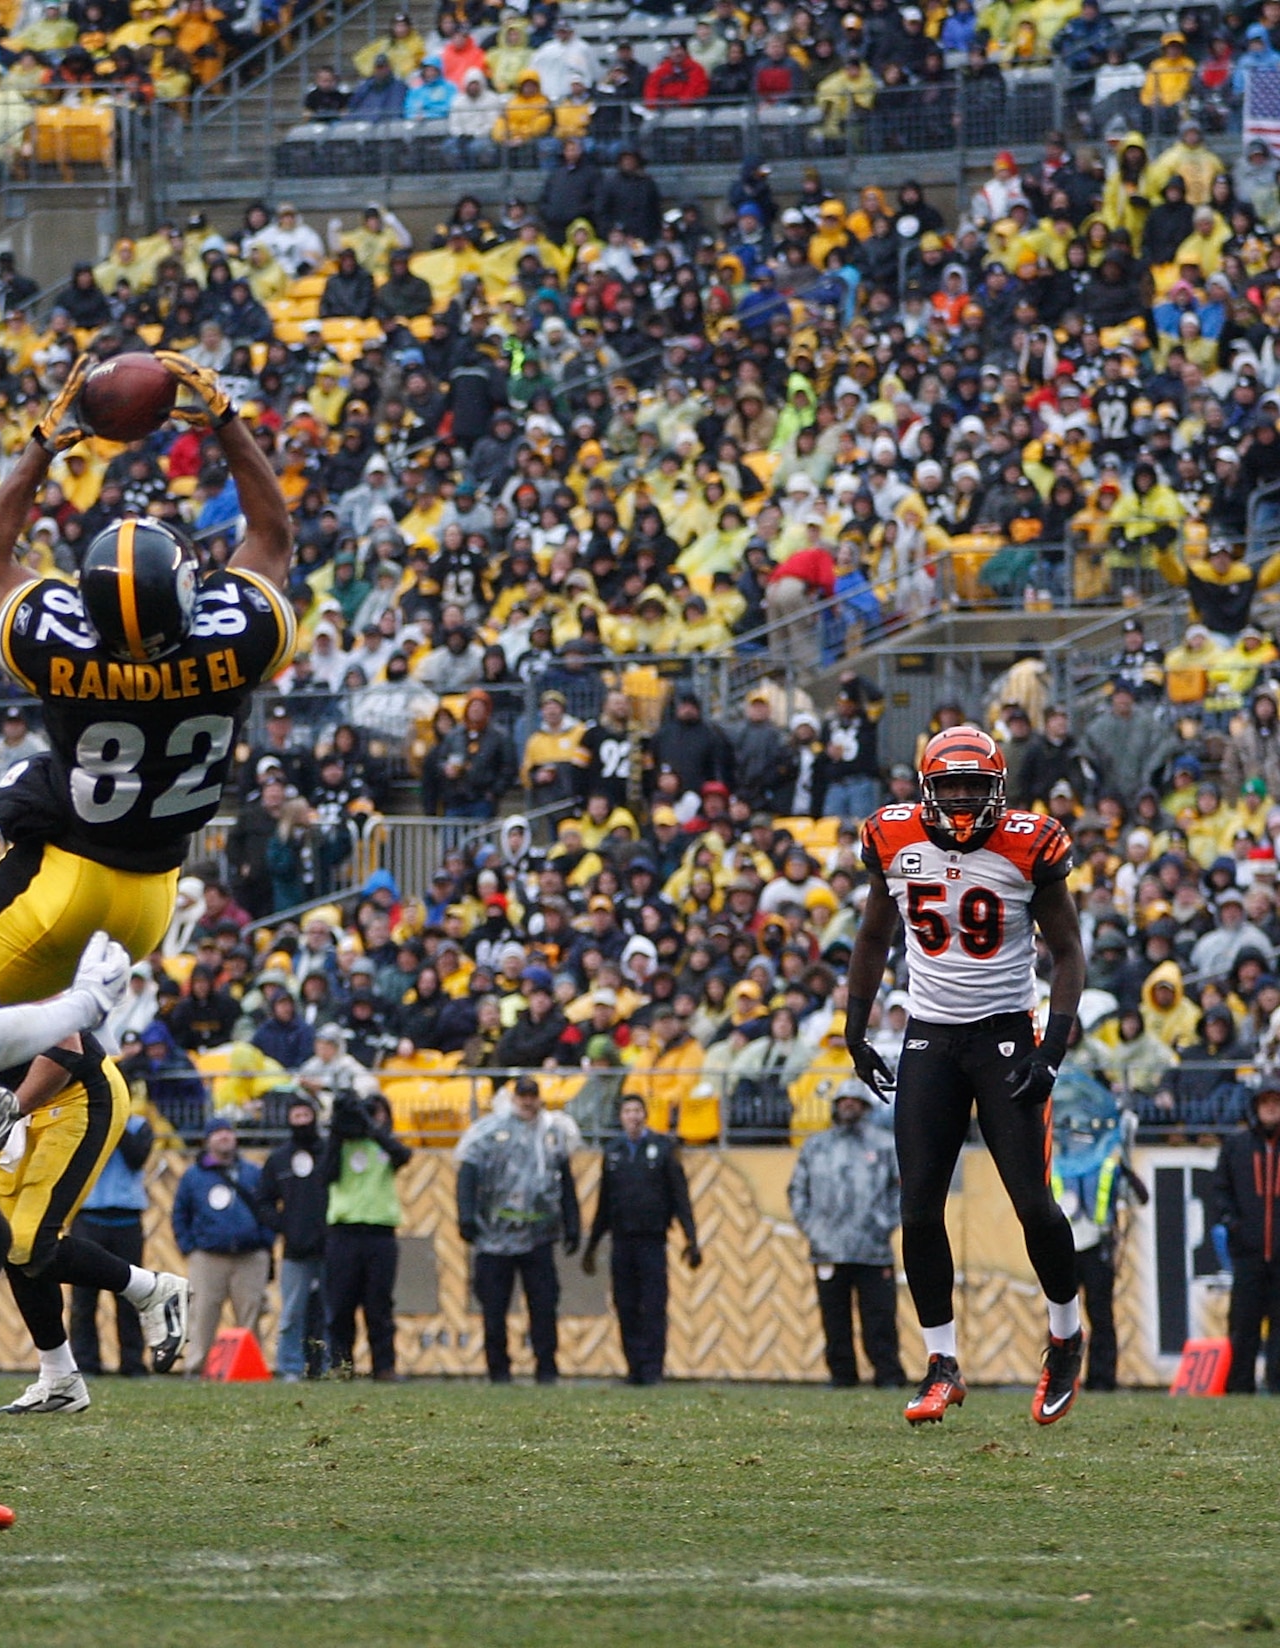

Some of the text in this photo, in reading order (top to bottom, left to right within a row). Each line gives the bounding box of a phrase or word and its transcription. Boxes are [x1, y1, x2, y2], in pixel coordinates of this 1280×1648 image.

[50, 648, 246, 702] RANDLE EL
[71, 714, 234, 824] 82
[907, 881, 1005, 960] 59
[1175, 1349, 1220, 1394] 30
